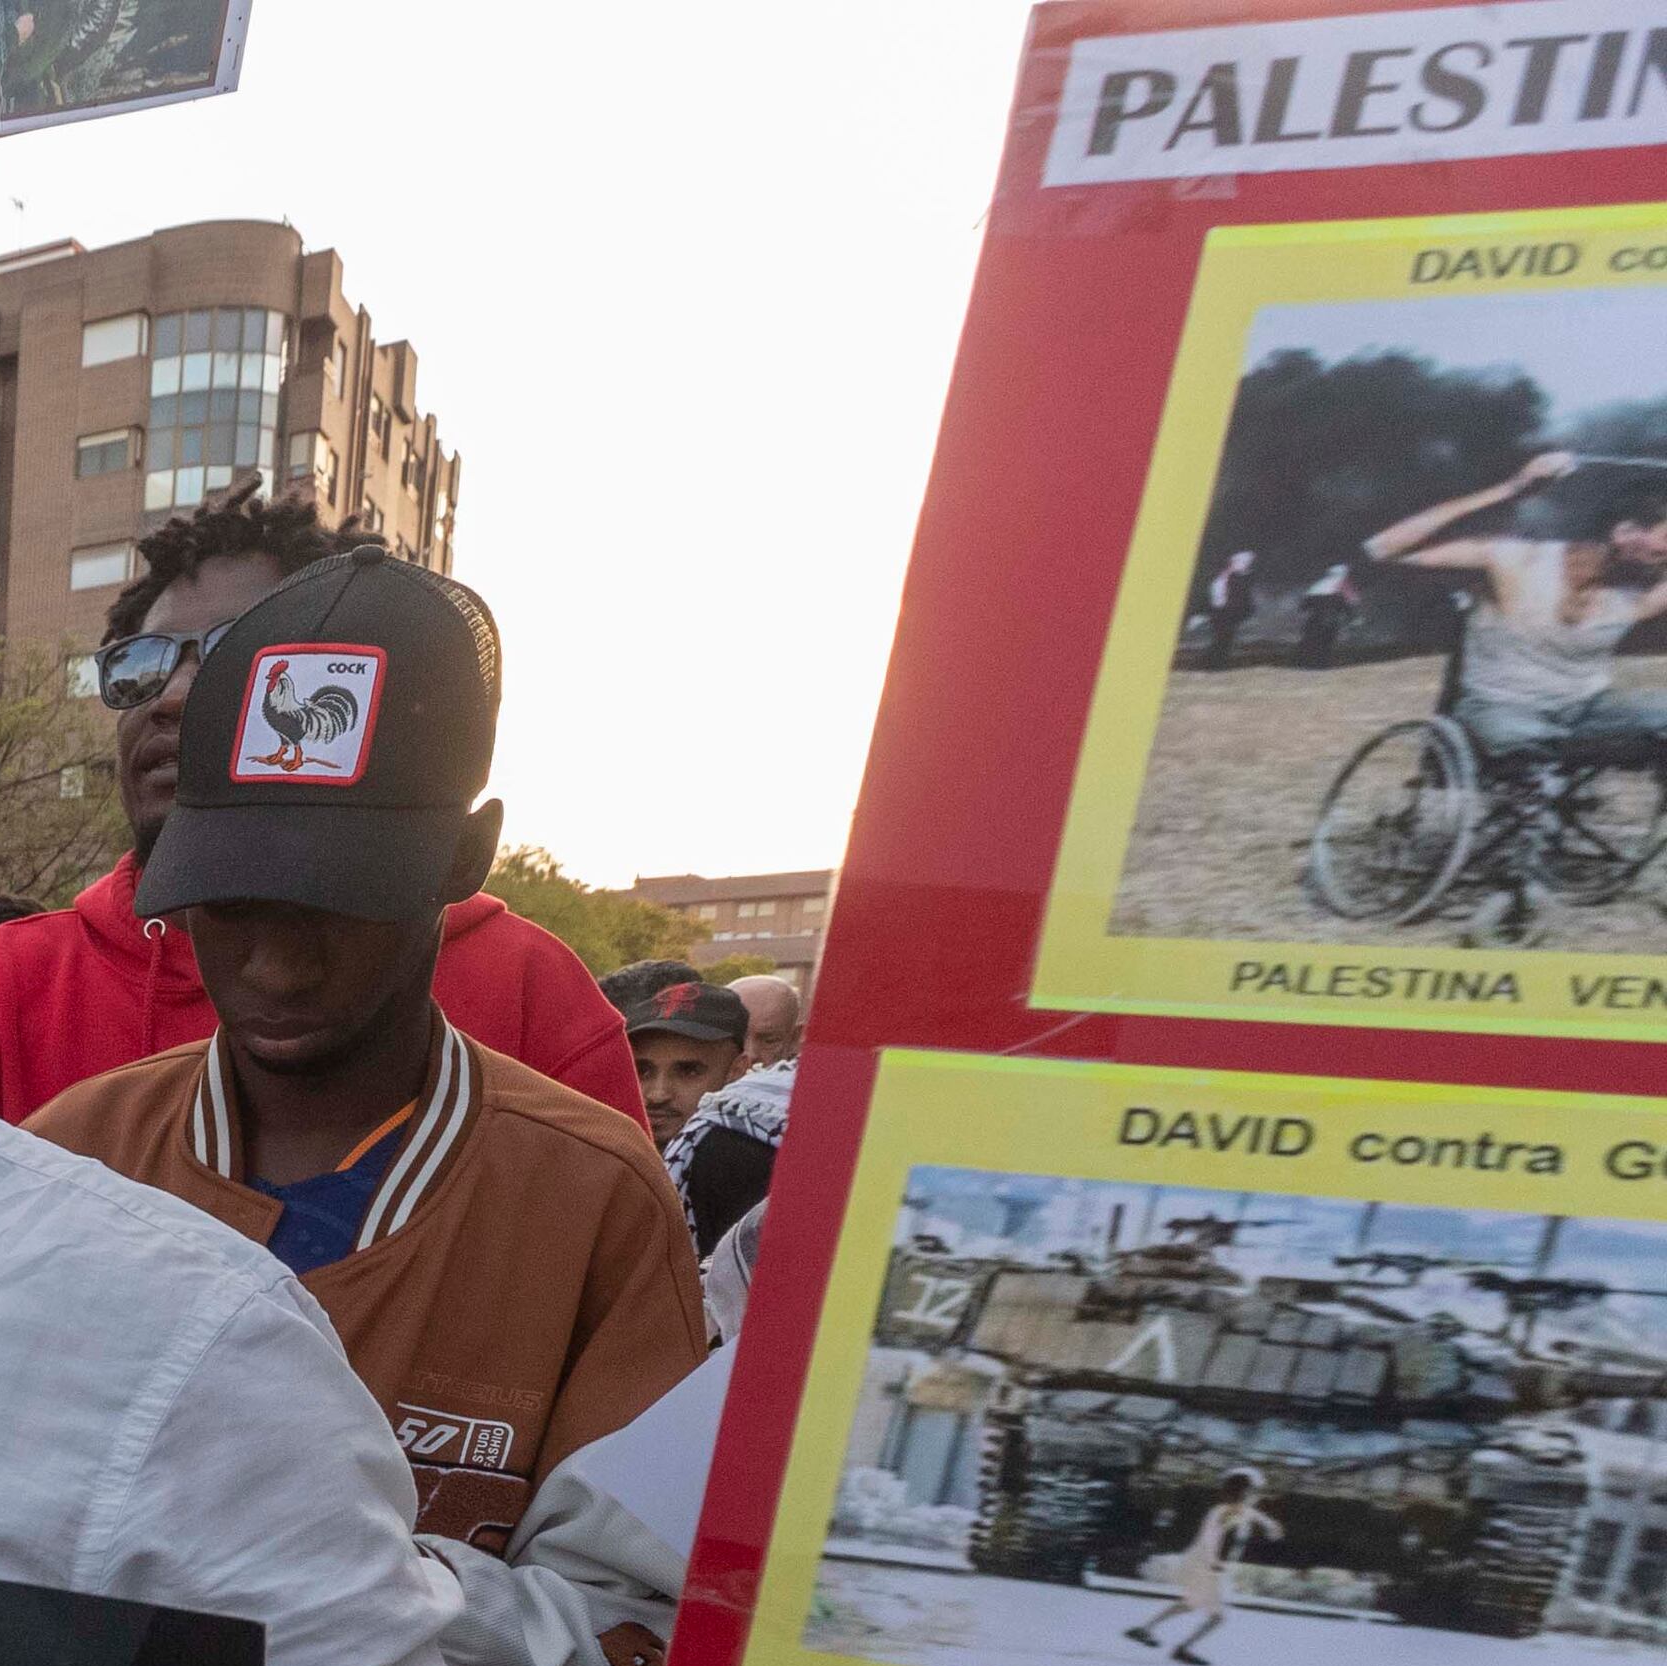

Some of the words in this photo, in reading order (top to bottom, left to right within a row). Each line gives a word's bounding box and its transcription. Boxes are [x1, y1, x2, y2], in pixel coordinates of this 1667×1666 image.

[1408, 241, 1585, 285] DAVID
[327, 662, 368, 675] COCK
[1227, 960, 1524, 1003] PALESTINA
[1116, 1106, 1316, 1158] DAVID
[1348, 1130, 1564, 1176] contra
